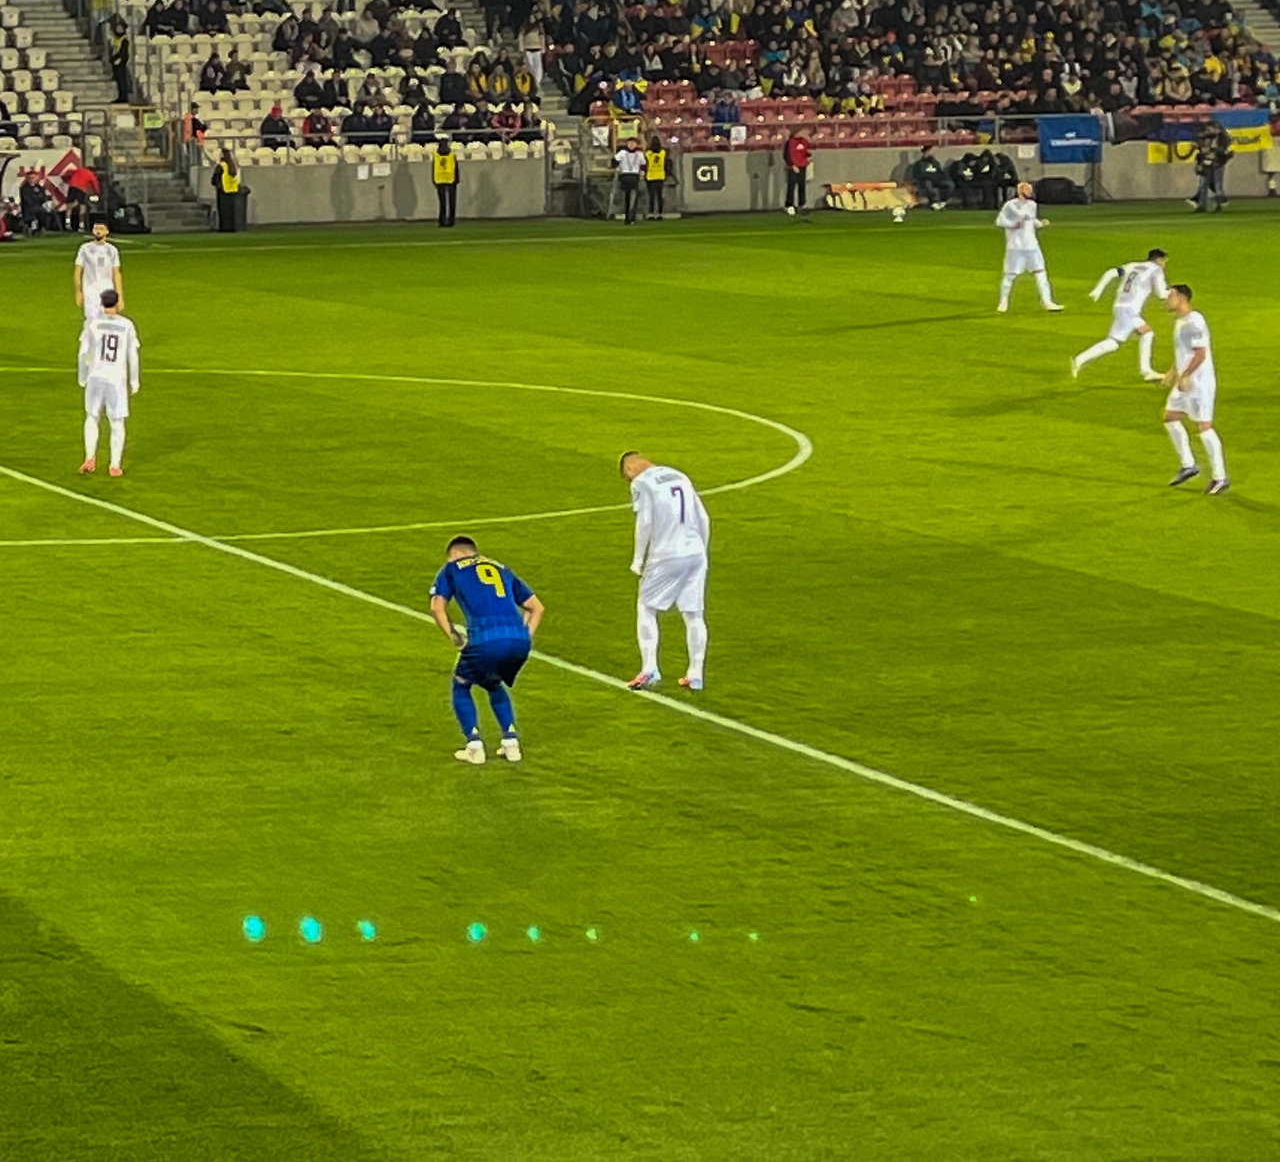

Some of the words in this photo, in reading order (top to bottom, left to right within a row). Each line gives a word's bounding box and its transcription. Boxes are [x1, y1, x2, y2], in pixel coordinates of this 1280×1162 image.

[696, 165, 718, 182] G1
[100, 333, 119, 363] 19
[670, 486, 686, 525] 7
[476, 564, 506, 598] 9
